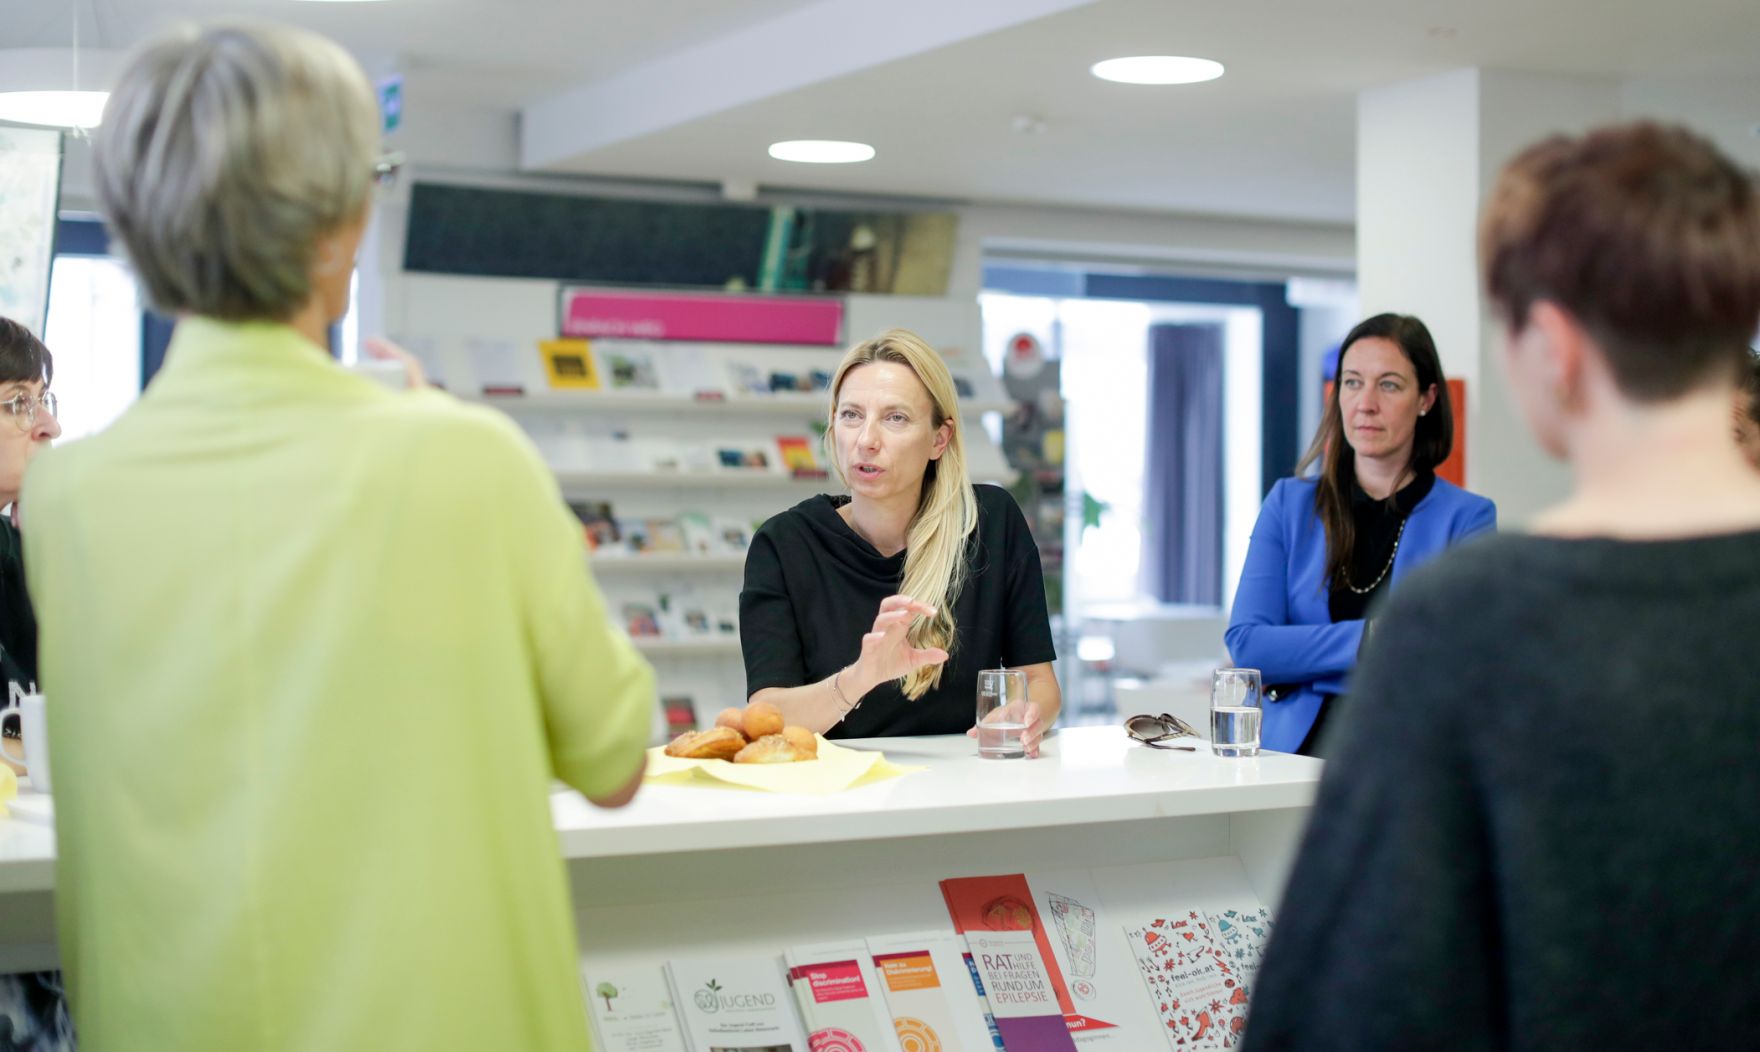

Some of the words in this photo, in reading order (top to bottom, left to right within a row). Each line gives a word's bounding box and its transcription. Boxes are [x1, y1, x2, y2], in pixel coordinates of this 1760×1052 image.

[981, 954, 1012, 970] RAT
[1014, 953, 1033, 961] UND
[1012, 961, 1037, 970] HILFE
[813, 976, 861, 987] discrimination!
[988, 971, 1001, 980] BEI
[1003, 970, 1040, 980] FRAGEN
[991, 980, 1023, 992] RUND
[1024, 979, 1045, 991] UM
[719, 992, 776, 1009] JUGEND
[995, 991, 1048, 1004] EPILEPSIE
